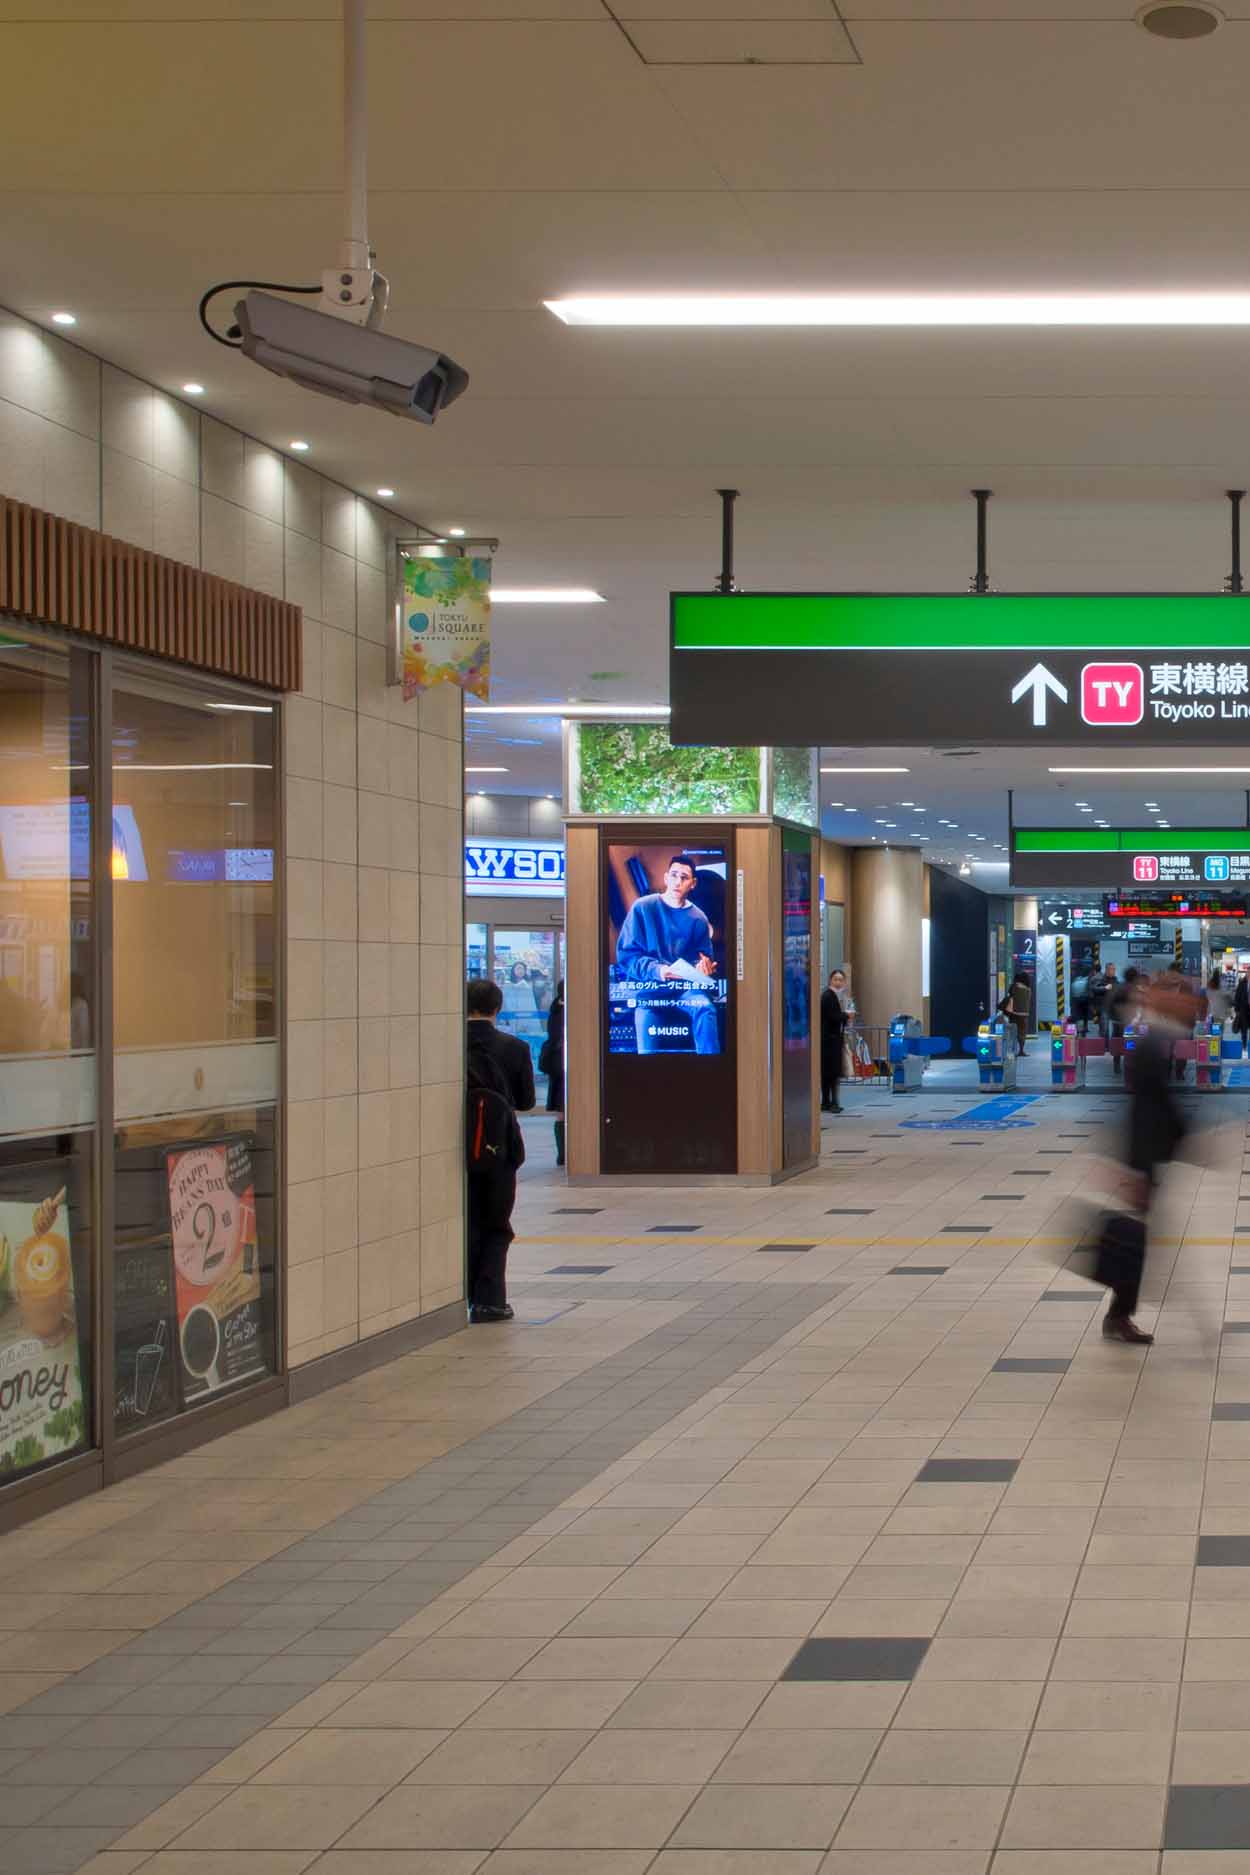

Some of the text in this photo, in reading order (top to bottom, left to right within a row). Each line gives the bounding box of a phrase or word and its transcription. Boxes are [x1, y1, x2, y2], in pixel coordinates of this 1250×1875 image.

[438, 623, 487, 634] SQUARE
[1150, 662, 1249, 696] 東横線
[1092, 681, 1134, 708] TY
[466, 848, 565, 879] WSO
[1138, 867, 1153, 878] 11
[1210, 867, 1224, 878] 11
[1024, 938, 1033, 954] 2
[657, 1026, 689, 1036] MUSIC
